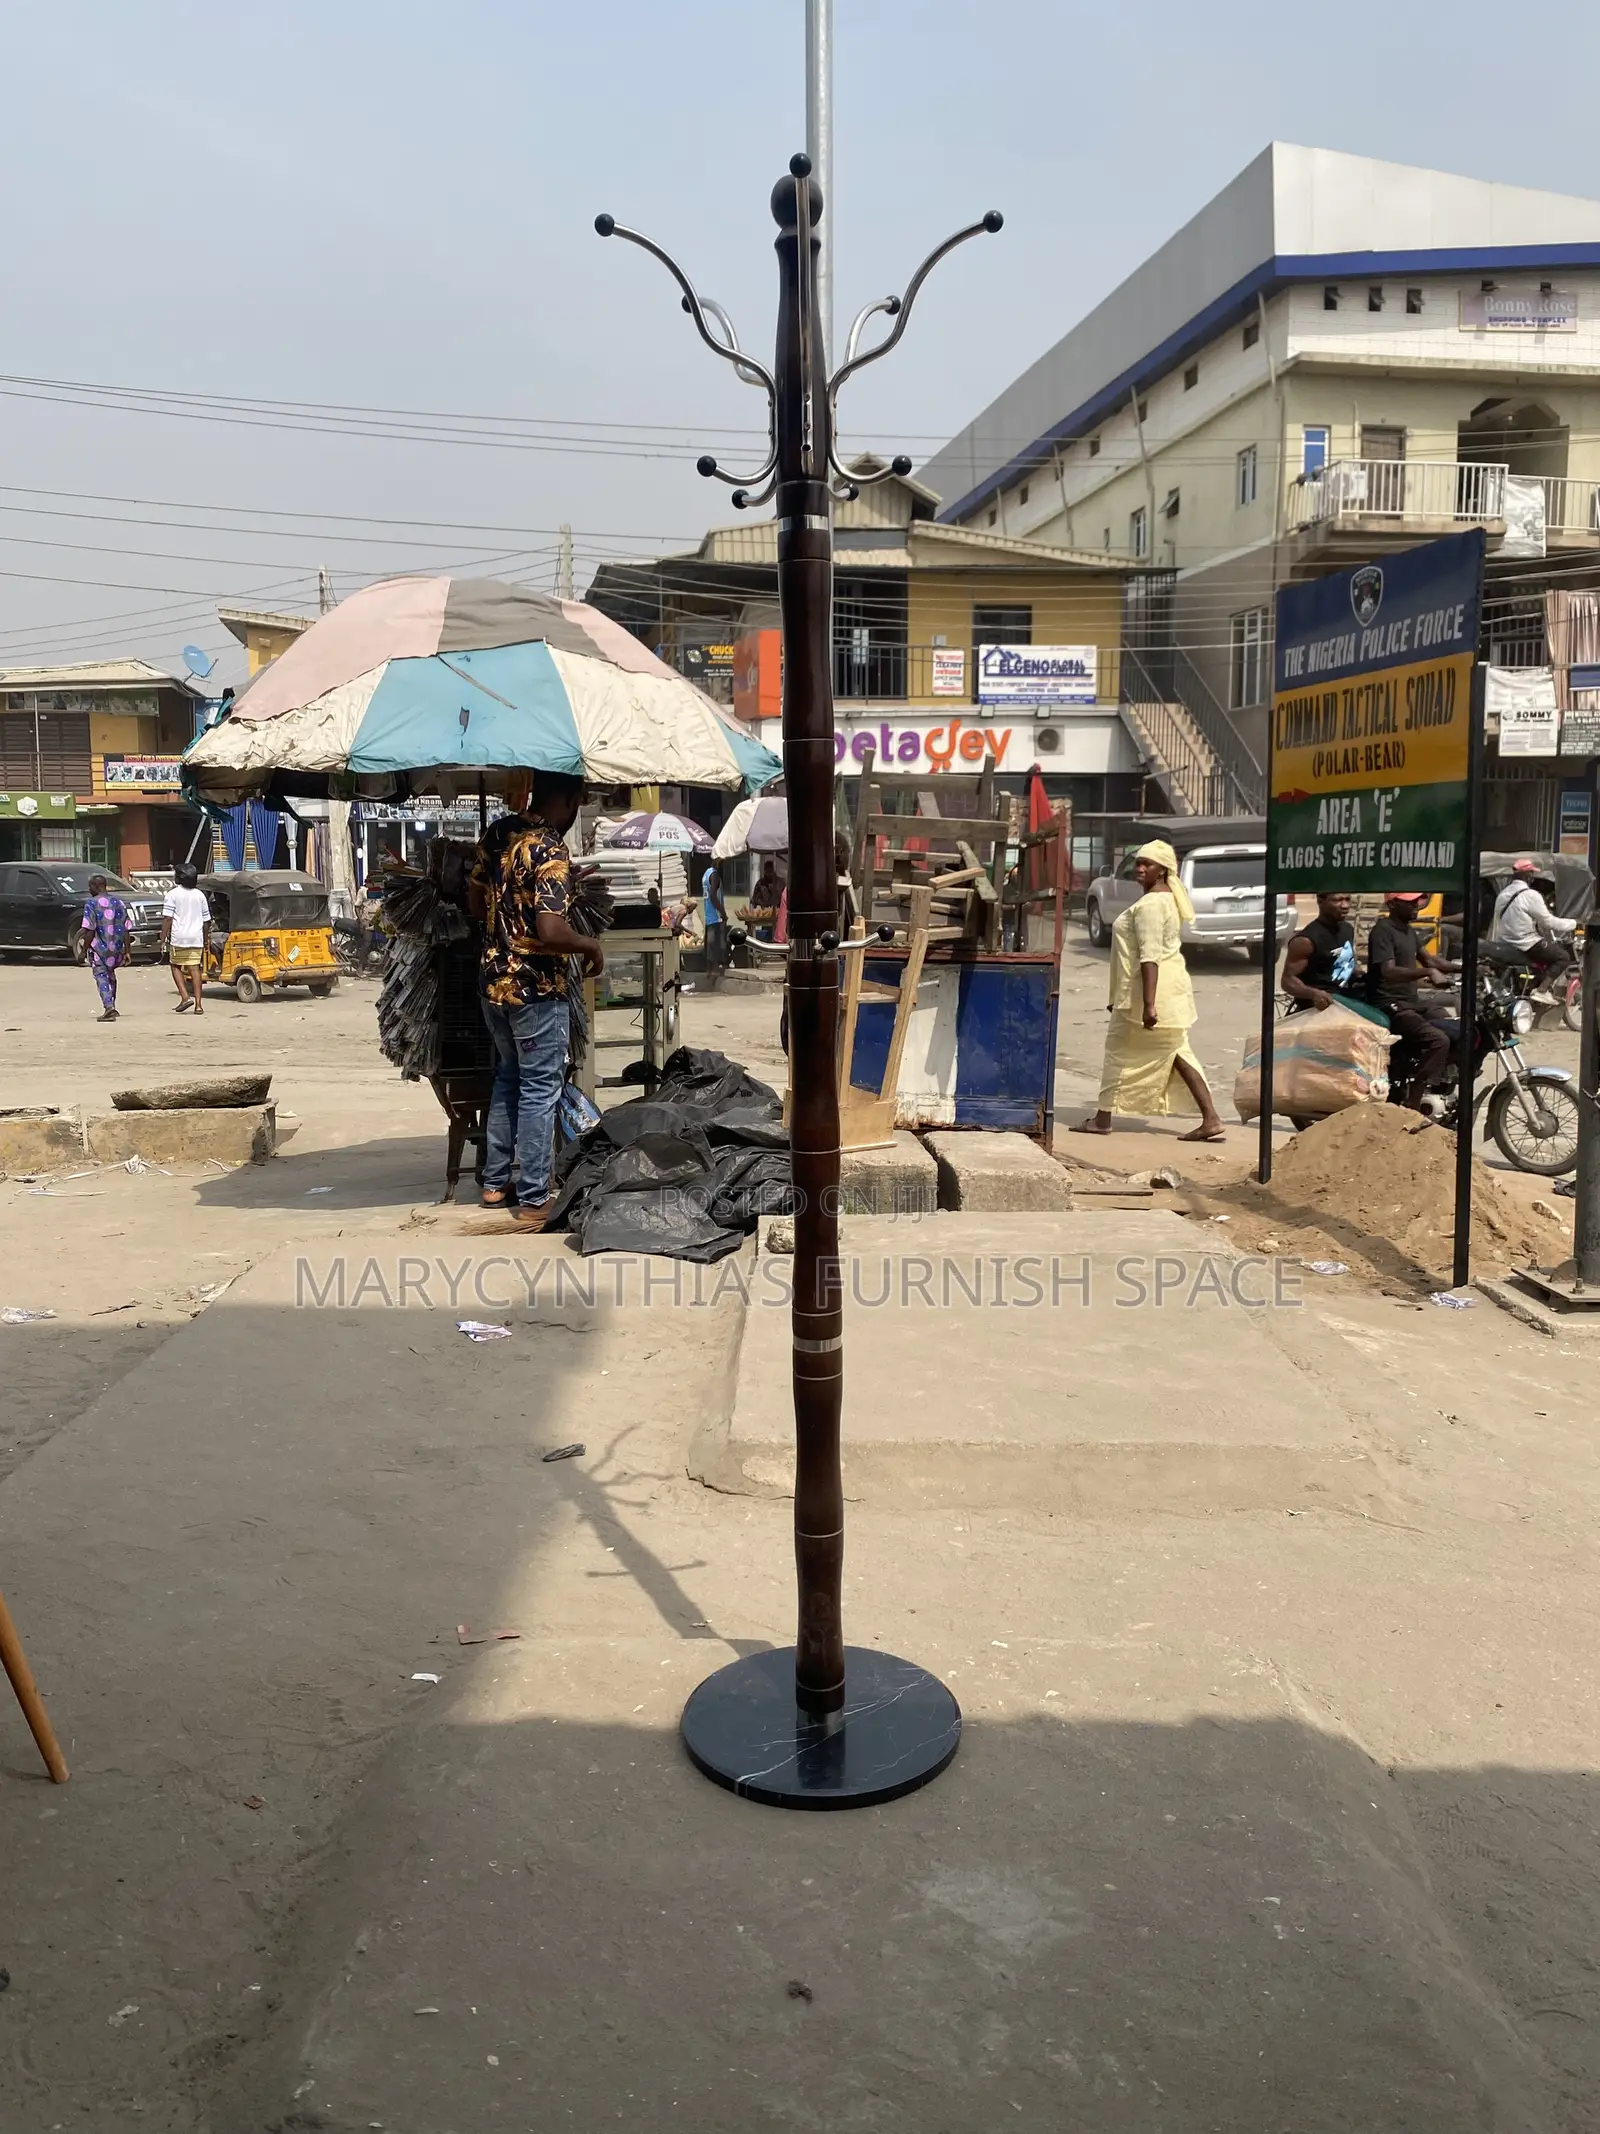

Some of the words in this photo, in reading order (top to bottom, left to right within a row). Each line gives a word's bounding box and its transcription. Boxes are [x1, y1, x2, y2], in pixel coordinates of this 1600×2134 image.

[1484, 296, 1532, 315] Bonny
[1540, 298, 1576, 313] Rose
[1284, 645, 1305, 678] THE
[1307, 633, 1356, 673] NIGERIA
[1359, 618, 1411, 663] POLICE
[1413, 604, 1465, 649] FORCE
[1276, 691, 1338, 751] COMMAND
[1342, 678, 1398, 741] TACTICAL
[1405, 667, 1456, 734] SQUAD
[1312, 741, 1405, 779] (POLAR-BEAR)
[1316, 797, 1361, 835] AREA
[659, 831, 680, 840] POS
[1278, 844, 1324, 869] LAGOS
[1332, 841, 1375, 868] STATE
[1380, 841, 1456, 868] COMMAND
